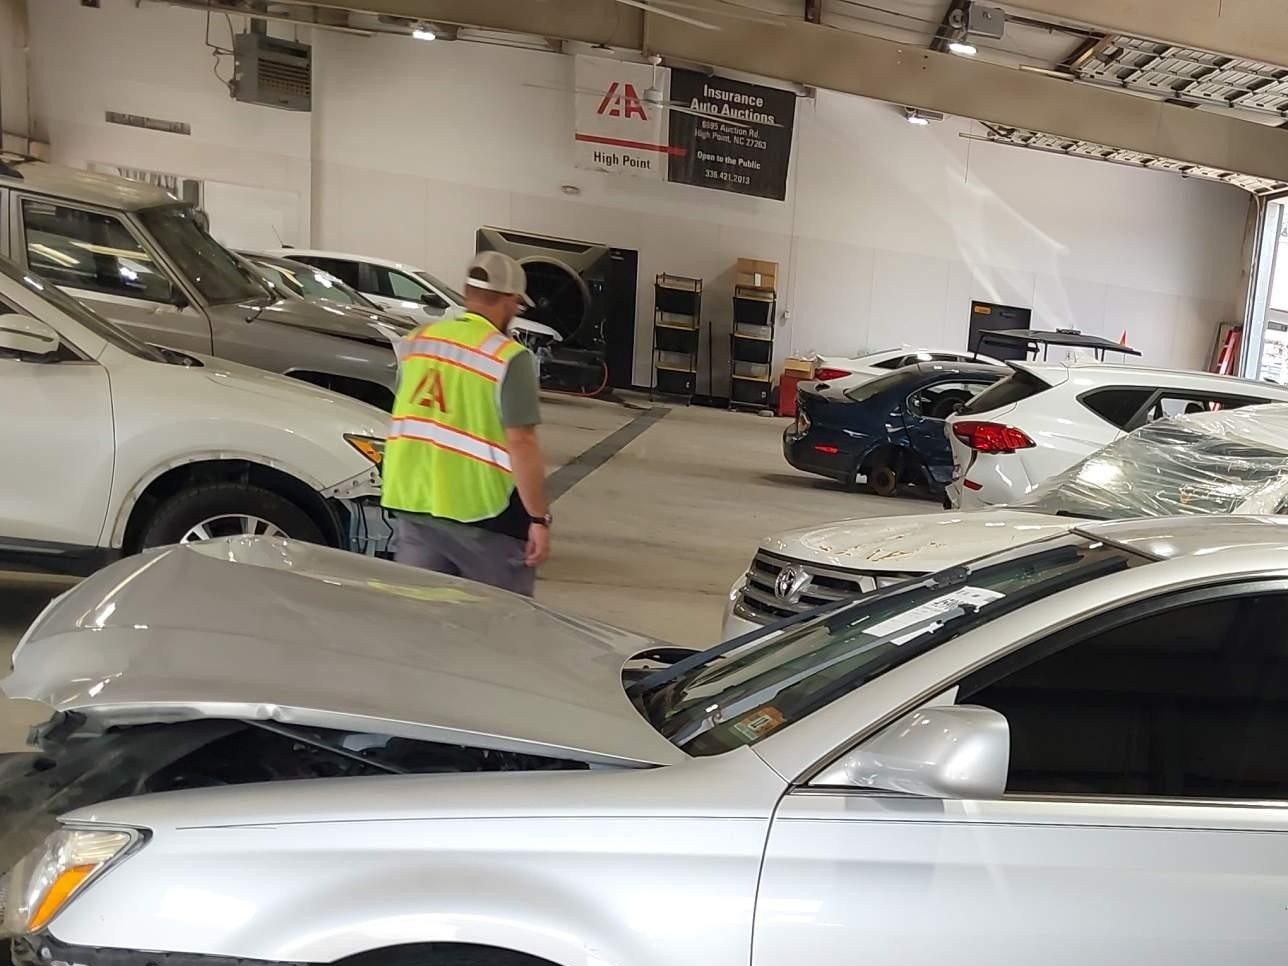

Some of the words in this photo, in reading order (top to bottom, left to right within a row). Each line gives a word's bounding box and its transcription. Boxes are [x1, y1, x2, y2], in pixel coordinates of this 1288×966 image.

[703, 83, 764, 108] Insurance
[690, 97, 719, 114] Auto
[721, 103, 775, 125] Auctions
[695, 128, 711, 141] High
[734, 136, 745, 146] NC
[720, 123, 748, 136] Auction
[749, 128, 760, 139] Rd.
[593, 151, 619, 167] High
[622, 155, 652, 169] Point
[697, 150, 716, 162] Open
[716, 154, 724, 163] to
[725, 155, 737, 166] the
[738, 158, 761, 170] Public
